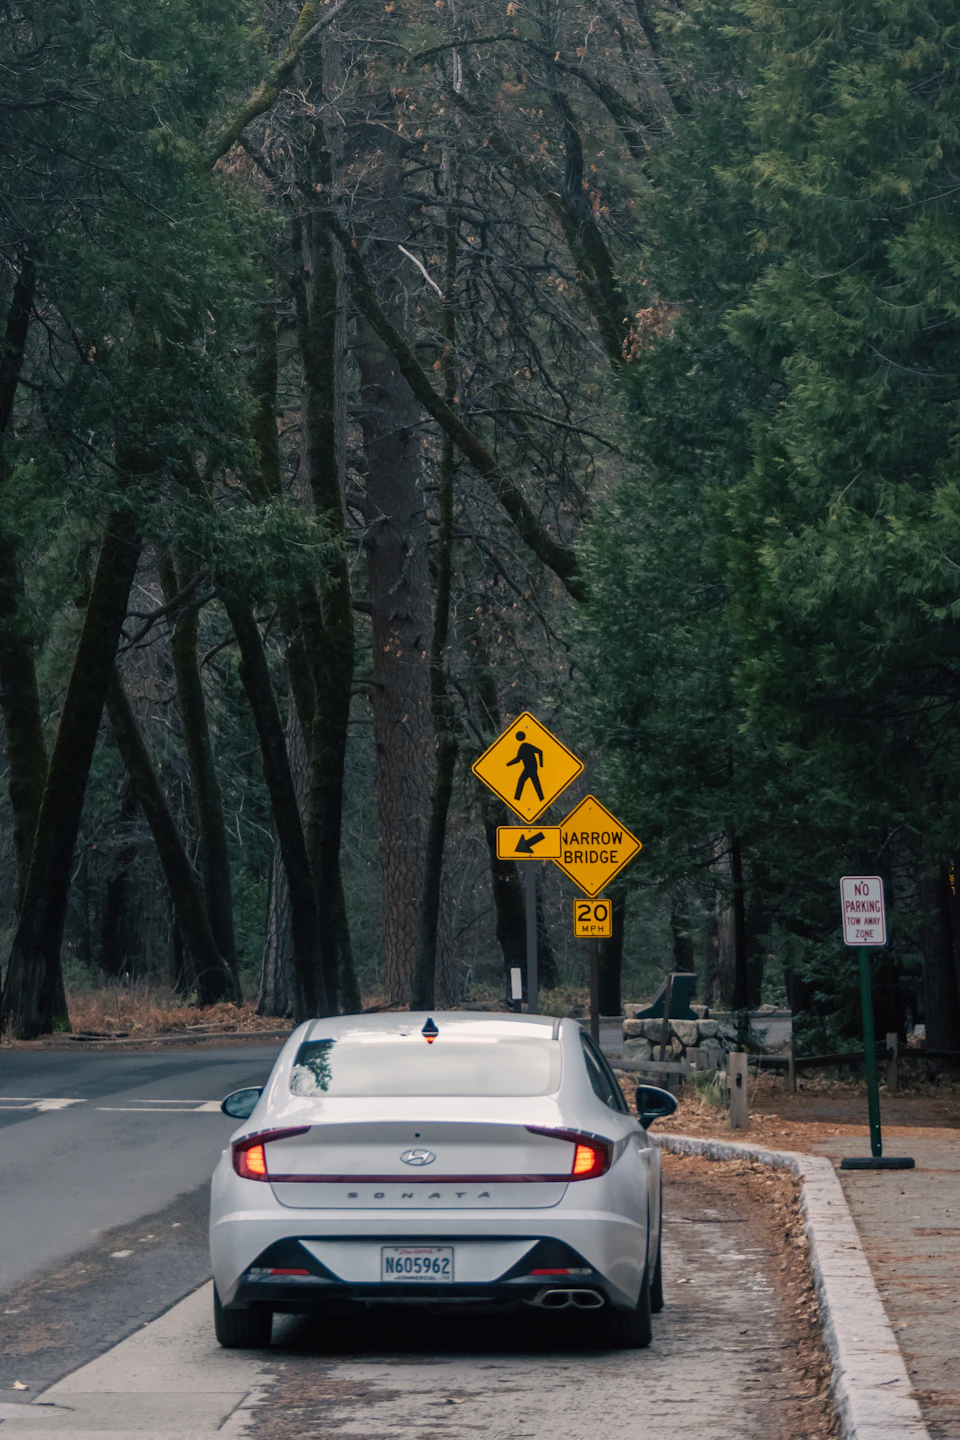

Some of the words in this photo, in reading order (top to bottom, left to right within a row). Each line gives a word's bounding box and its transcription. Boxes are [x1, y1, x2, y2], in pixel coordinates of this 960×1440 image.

[562, 831, 623, 845] NARROW
[564, 850, 619, 864] BRIDGE
[854, 883, 870, 896] NO
[577, 904, 608, 922] 20
[845, 900, 881, 913] PARKING
[847, 916, 861, 926] TOW
[863, 916, 881, 926] AWAY
[855, 929, 875, 939] ZONE
[346, 1191, 491, 1199] SONATA
[385, 1257, 450, 1274] N605962
